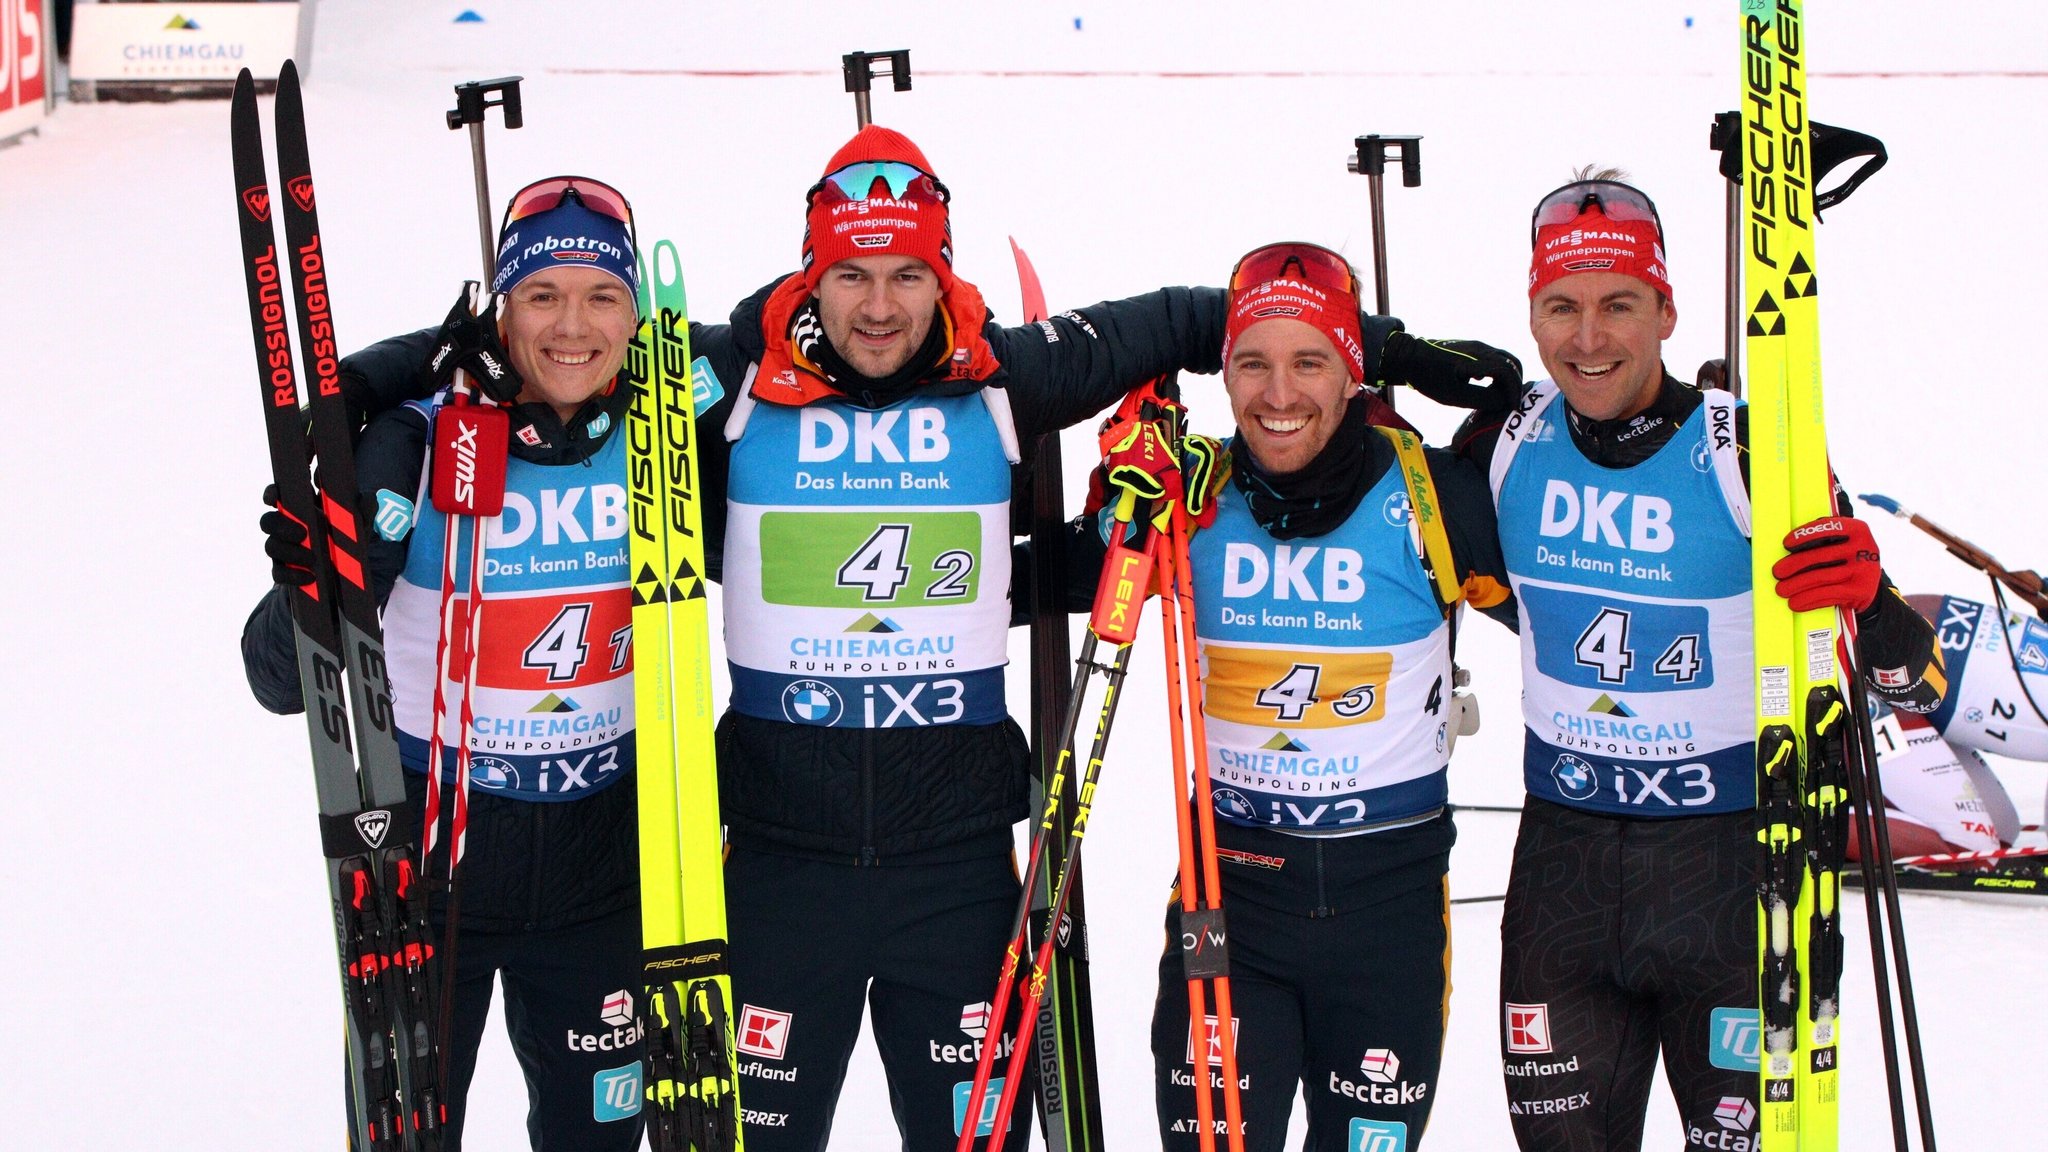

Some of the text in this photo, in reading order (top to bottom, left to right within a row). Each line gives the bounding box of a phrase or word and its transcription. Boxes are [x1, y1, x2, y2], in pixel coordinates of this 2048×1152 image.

[123, 44, 244, 60] CHIEMGAU
[1746, 14, 1778, 270] FISCHER
[831, 198, 918, 216] VIESSMANN
[834, 217, 917, 234] Wärmepumpen
[1546, 229, 1636, 249] VIESSMANN
[523, 236, 621, 260] robotron
[1545, 246, 1635, 264] Wärmepumpen
[1237, 295, 1323, 317] Wärmepumpen
[1238, 280, 1326, 305] VIESSMANN
[255, 245, 295, 407] ROSSIGNOL
[300, 235, 340, 397] ROSSIGNOL
[661, 306, 695, 539] FISCHER
[798, 407, 951, 463] DKB
[1617, 416, 1664, 442] tectake
[1143, 424, 1154, 461] LEKI
[795, 472, 951, 490] Das kann Bank
[486, 483, 630, 550] DKB
[1540, 479, 1675, 553] DKB
[483, 548, 629, 577] Das kann Bank
[835, 523, 976, 602] 4 2
[1222, 542, 1366, 603] DKB
[1537, 546, 1673, 582] Das kann Bank
[1108, 556, 1139, 633] LEKI
[1222, 607, 1363, 631] Das kann Bank
[521, 602, 593, 683] 4
[790, 635, 955, 659] CHIEMGAU
[1574, 606, 1703, 686] 4 4
[790, 658, 956, 673] RUHPOLDING
[1255, 663, 1323, 721] 4
[1424, 674, 1443, 717] 4
[1866, 675, 1924, 694] Kaufland
[864, 679, 966, 729] iX3
[473, 706, 622, 738] CHIEMGAU
[1553, 711, 1694, 743] CHIEMGAU
[471, 728, 618, 751] RUHPOLDING
[1556, 732, 1696, 757] RUHPOLDING
[1874, 724, 1896, 758] 1
[538, 745, 619, 793] iX3
[1219, 748, 1360, 778] CHIEMGAU
[1042, 750, 1071, 830] LEKI
[1219, 767, 1358, 792] RUHPOLDING
[1614, 764, 1716, 807] iX3
[1071, 758, 1103, 838] LEKI
[1974, 877, 2037, 889] FISCHER
[644, 952, 721, 971] FISCHER
[567, 1016, 644, 1052] tectak
[929, 1033, 1017, 1063] tectak
[738, 1061, 798, 1083] ufland
[1039, 997, 1063, 1116] ROSSIGNOL
[1816, 1053, 1832, 1066] 4/4
[1329, 1071, 1427, 1105] tectake
[1771, 1082, 1789, 1097] 4/4
[740, 1108, 789, 1127] ERREX
[1522, 1092, 1591, 1116] TERREX
